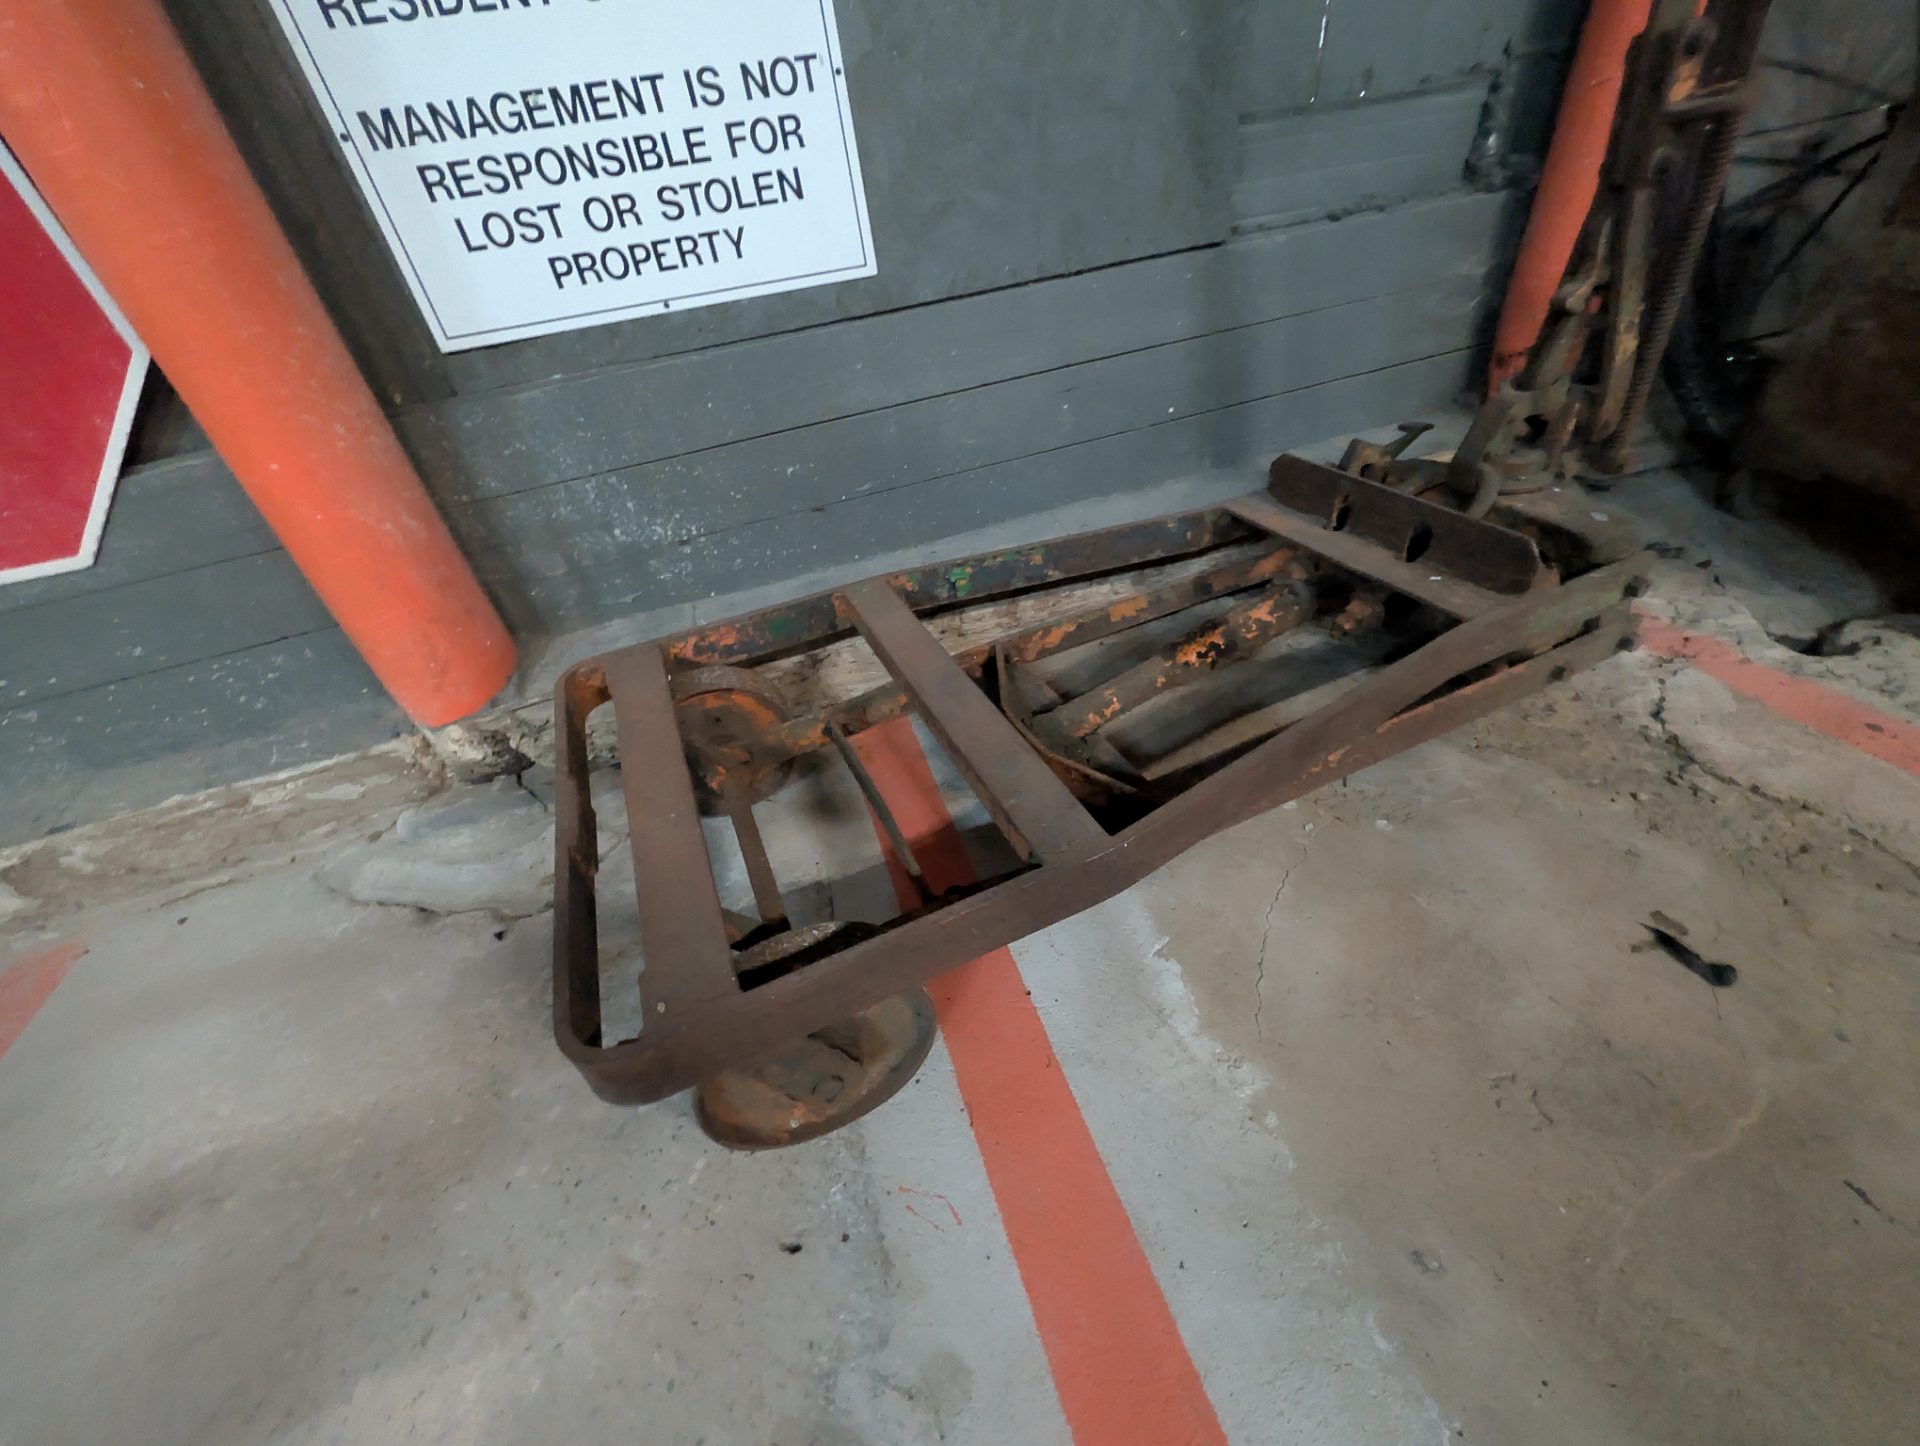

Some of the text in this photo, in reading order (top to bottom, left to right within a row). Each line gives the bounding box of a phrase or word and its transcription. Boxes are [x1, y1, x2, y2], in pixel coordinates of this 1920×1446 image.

[356, 54, 818, 151] MANAGEMENT IS NOT
[416, 114, 805, 203] RESPONSIBLE FOR
[454, 166, 804, 254] LOST OR STOLEN
[547, 226, 745, 289] PROPERTY
